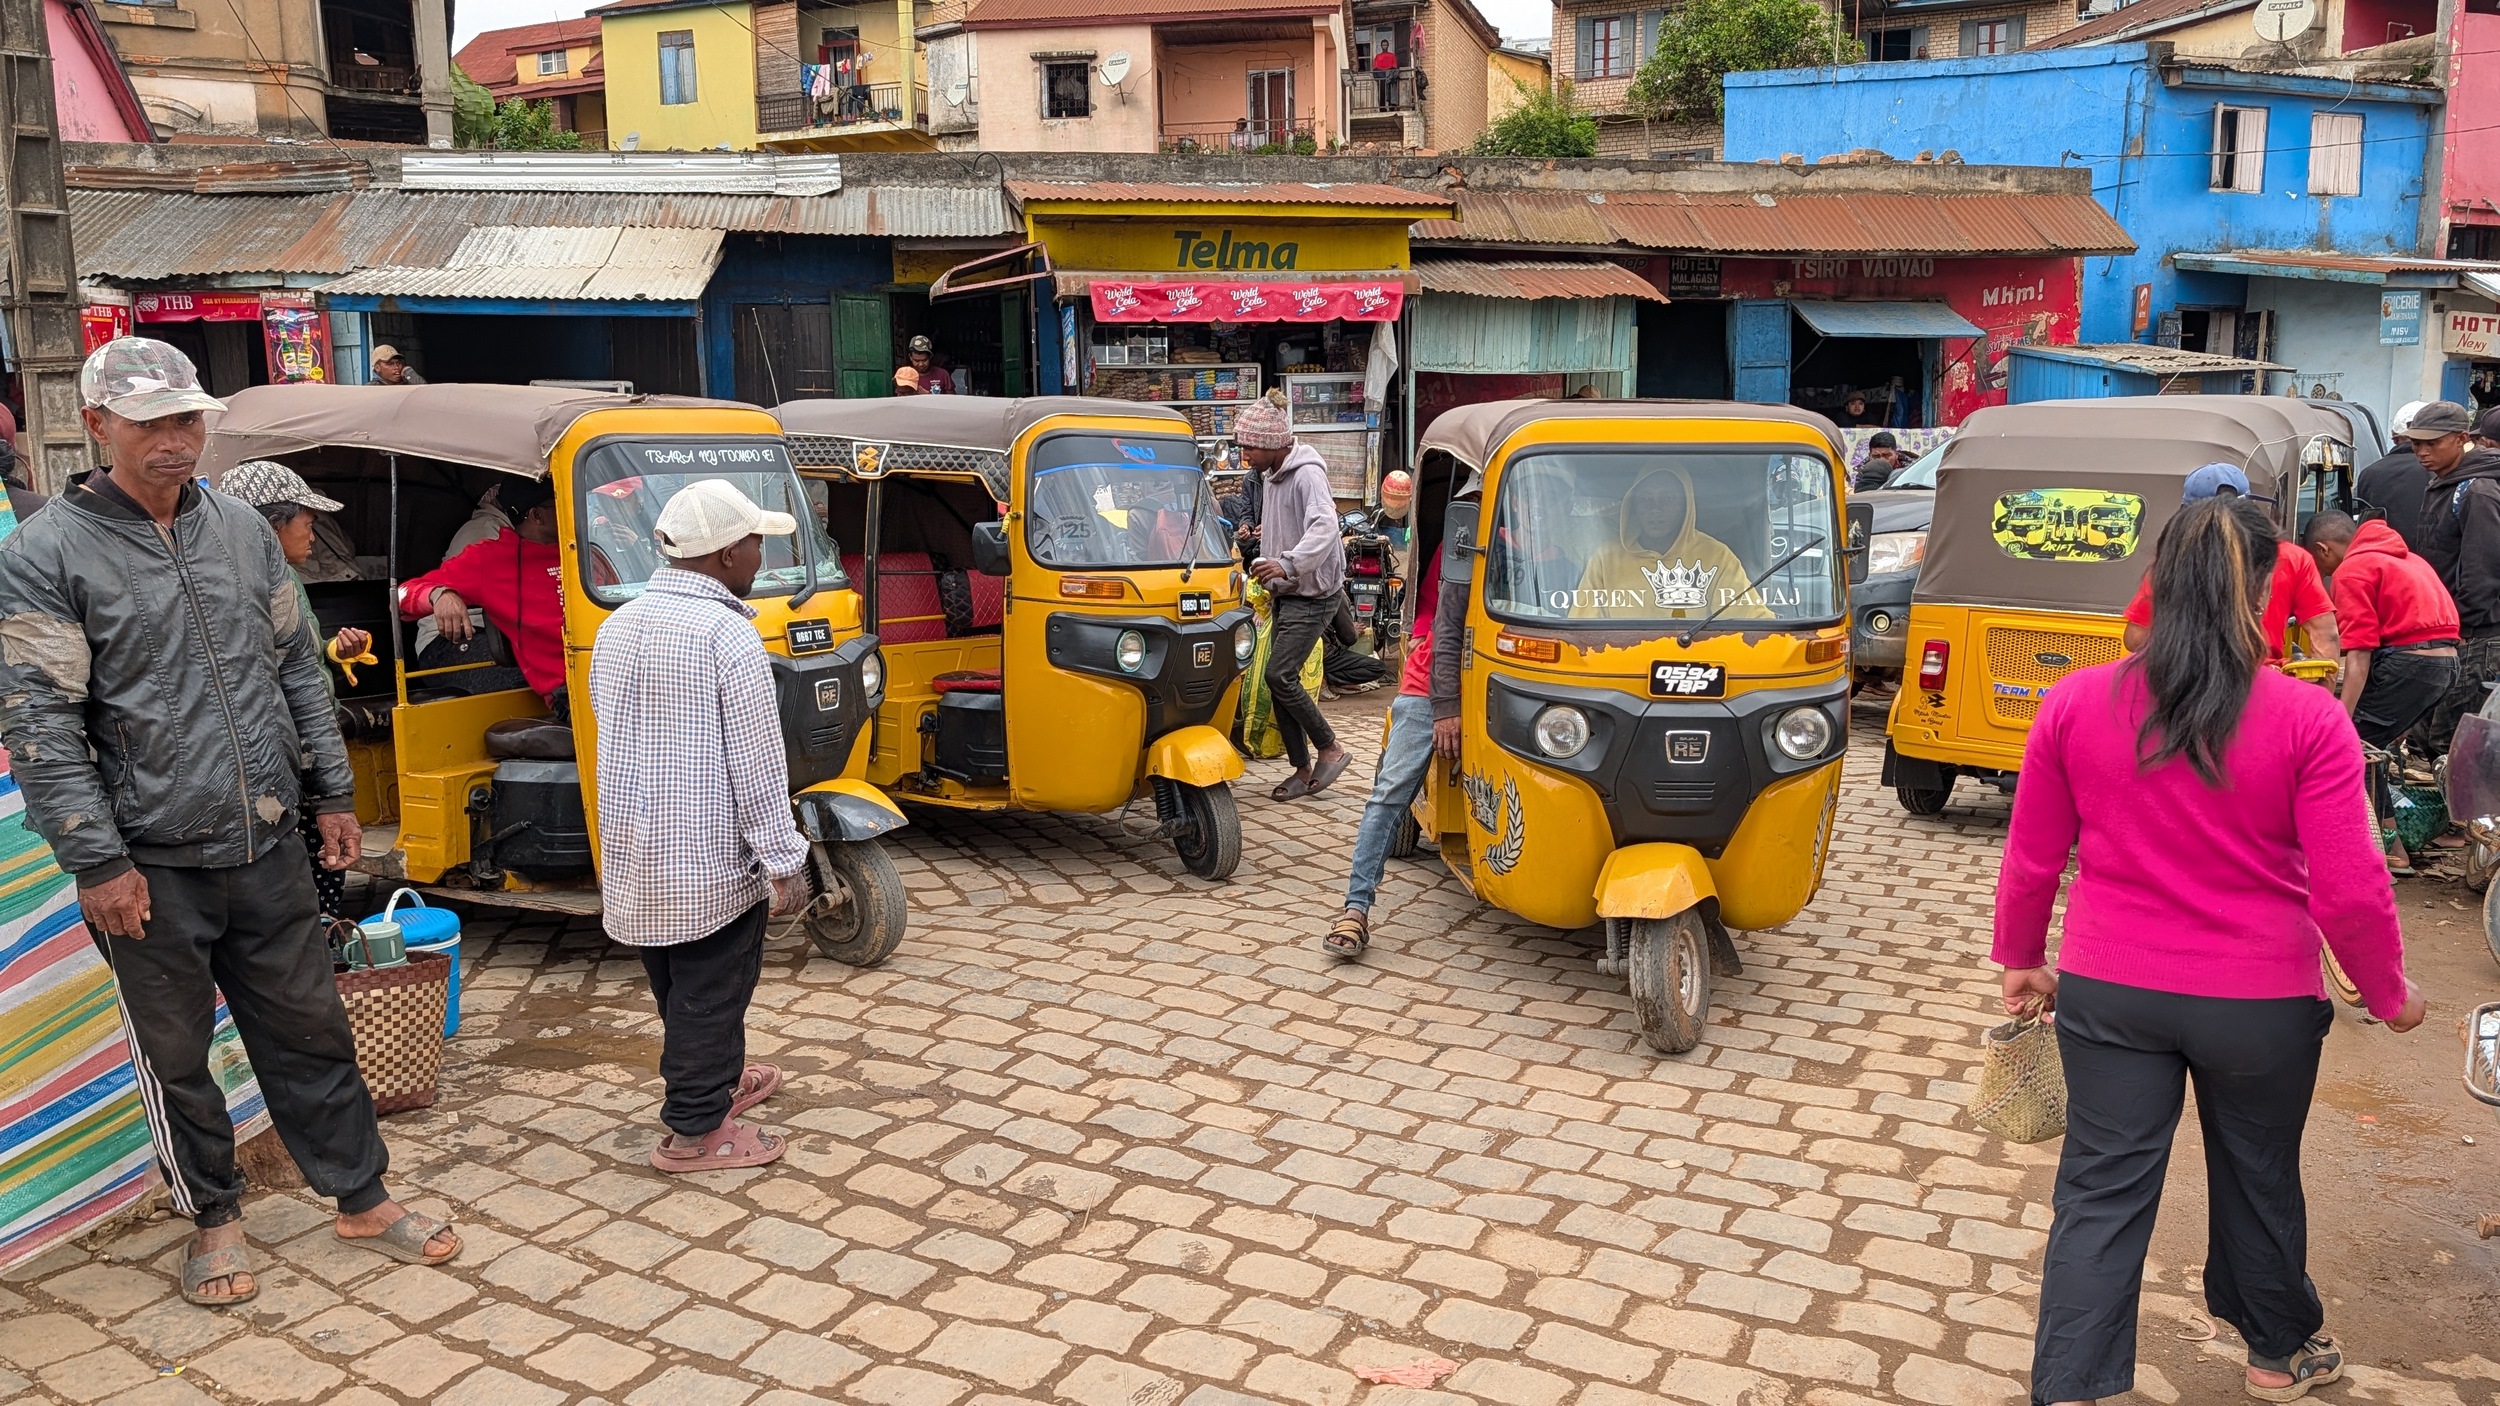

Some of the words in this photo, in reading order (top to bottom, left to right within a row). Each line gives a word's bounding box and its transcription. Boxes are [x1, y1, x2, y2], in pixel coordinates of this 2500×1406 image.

[2269, 1, 2303, 10] CANAL+
[1173, 229, 1299, 270] Telma
[1671, 257, 1721, 271] HOTELY
[1791, 259, 1849, 279] TSIRO
[1861, 258, 1935, 278] VAOVAO
[1672, 273, 1718, 284] MALAGASY
[1104, 285, 1133, 301] World
[1166, 285, 1195, 301] World
[1230, 286, 1259, 301] World
[1292, 286, 1320, 302] World
[1353, 286, 1382, 301] World
[1982, 278, 2044, 307] Mhm!
[161, 295, 194, 310] THB
[1115, 296, 1141, 308] Cola
[1176, 296, 1202, 308] Cola
[1241, 295, 1267, 308] Cola
[1302, 296, 1327, 308] Cola
[1364, 295, 1390, 308] Cola
[93, 306, 113, 318] THB
[2452, 315, 2500, 335] HOT
[1986, 335, 2031, 356] SUEME
[645, 449, 695, 464] TSARA
[698, 449, 718, 466] NY
[2040, 540, 2076, 552] DRIFT
[2067, 549, 2100, 559] KING
[1550, 589, 1648, 609] QUEEN
[1718, 588, 1801, 606] BAJAJ
[814, 629, 826, 641] TCE
[1197, 650, 1211, 663] RE
[1655, 666, 1720, 681] 0594
[1664, 679, 1709, 693] TBP
[1993, 683, 2032, 697] TEAM
[1674, 741, 1702, 757] RE
